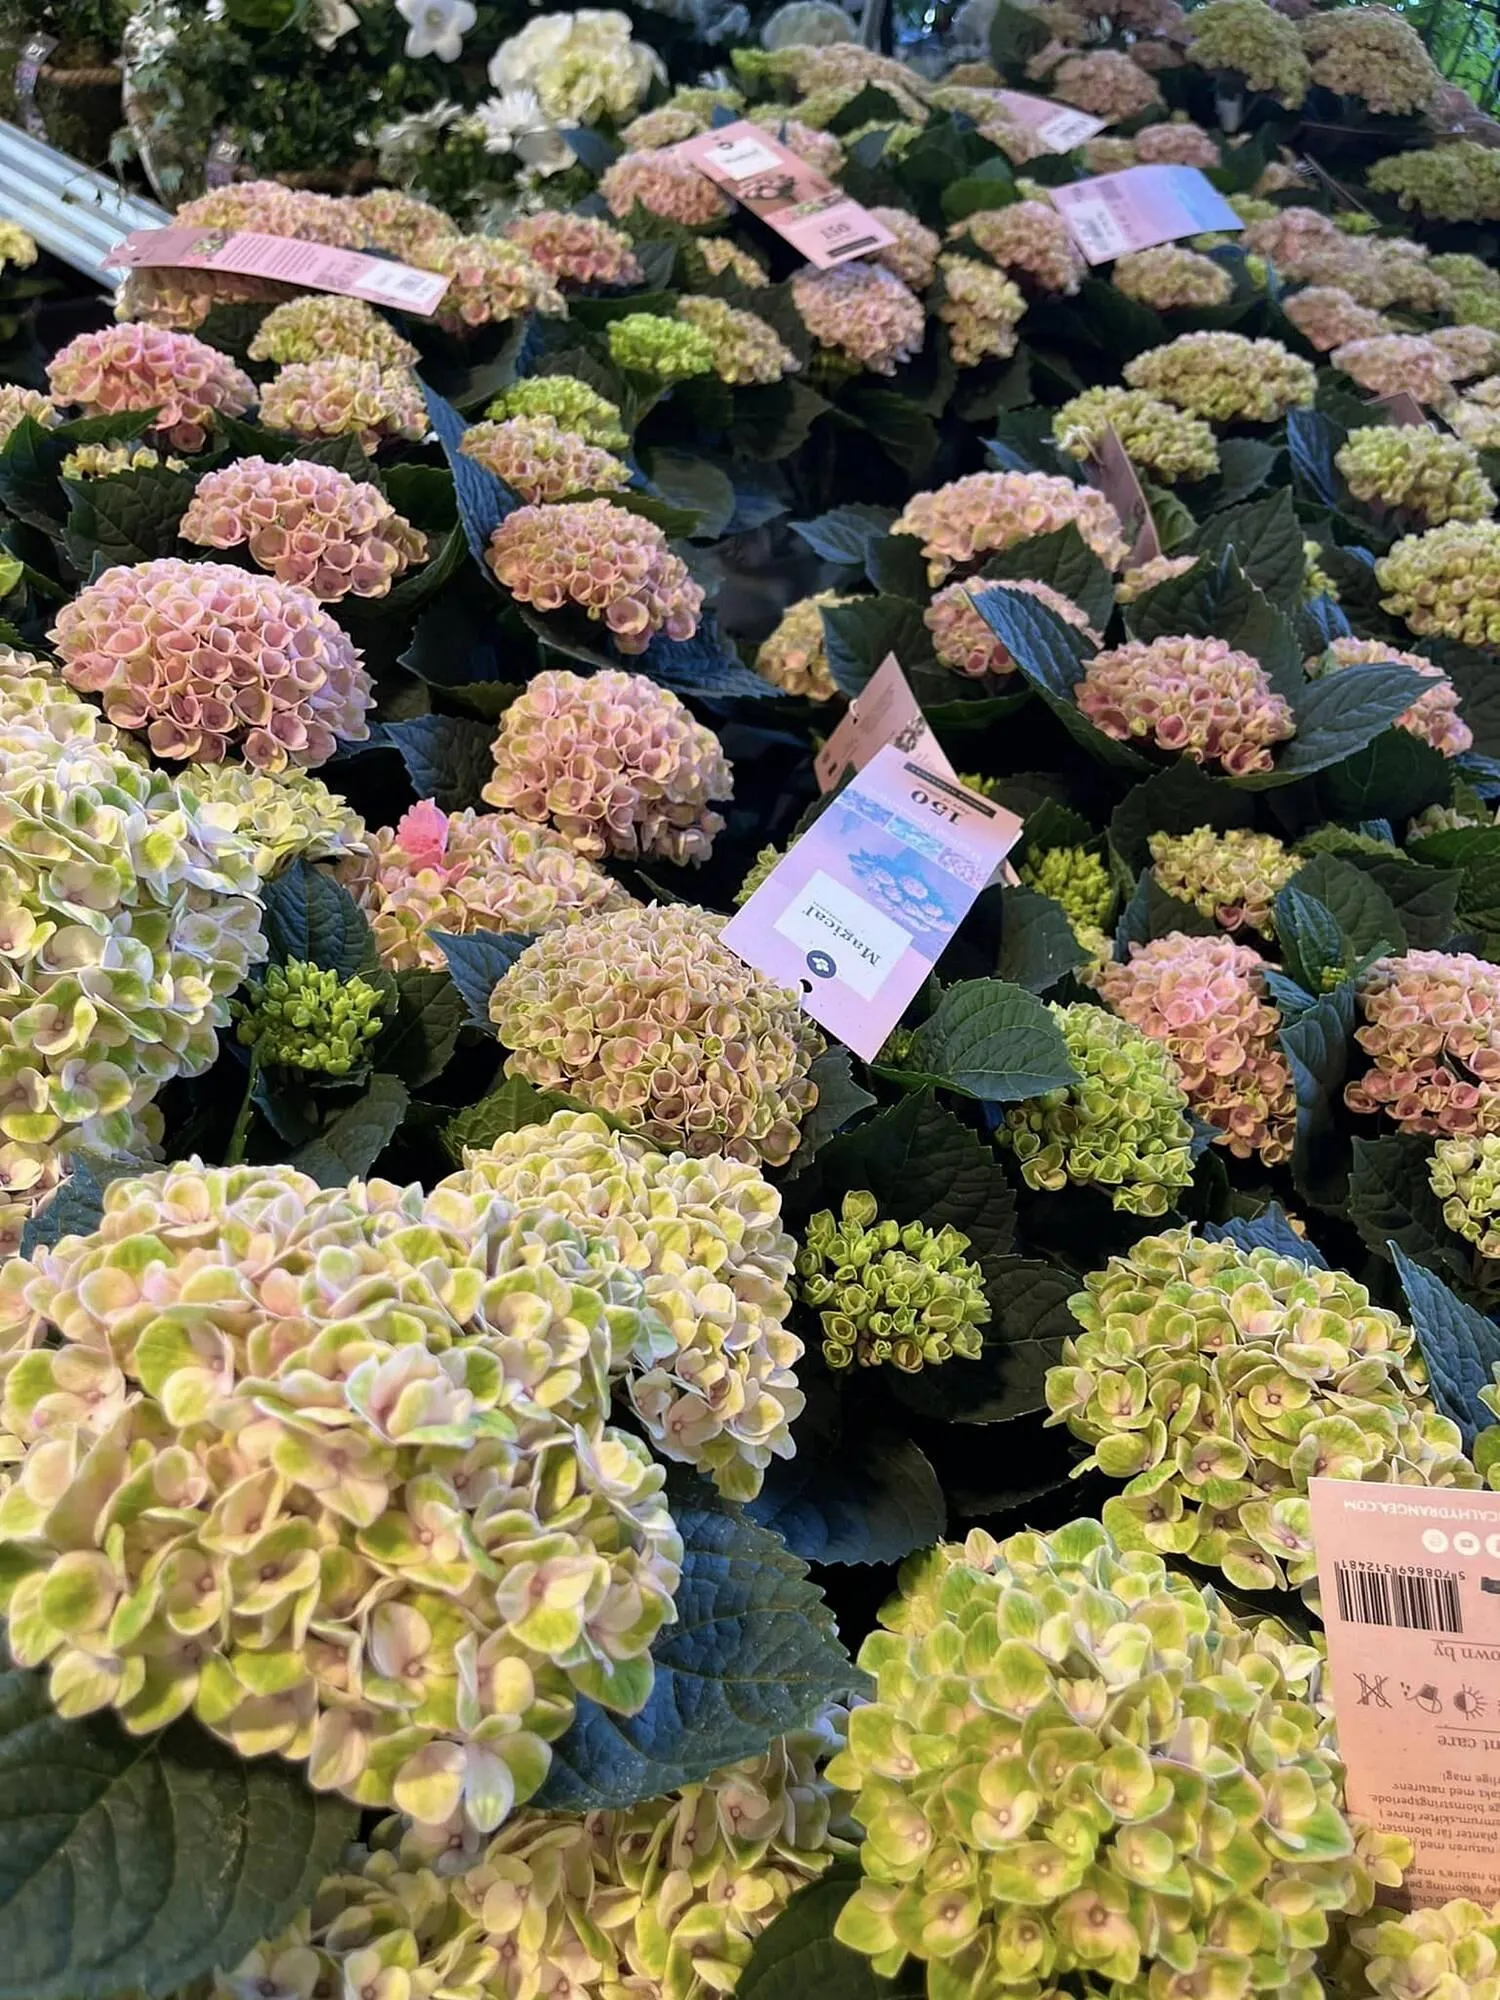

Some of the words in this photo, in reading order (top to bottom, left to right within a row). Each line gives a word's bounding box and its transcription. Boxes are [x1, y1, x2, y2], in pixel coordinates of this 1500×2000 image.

[910, 790, 960, 826] 150
[803, 905, 881, 967] Magical
[1433, 1641, 1456, 1662] by
[1437, 1736, 1477, 1750] care
[1449, 1787, 1475, 1798] med
[1456, 1830, 1498, 1842] planter
[1420, 1841, 1445, 1851] med
